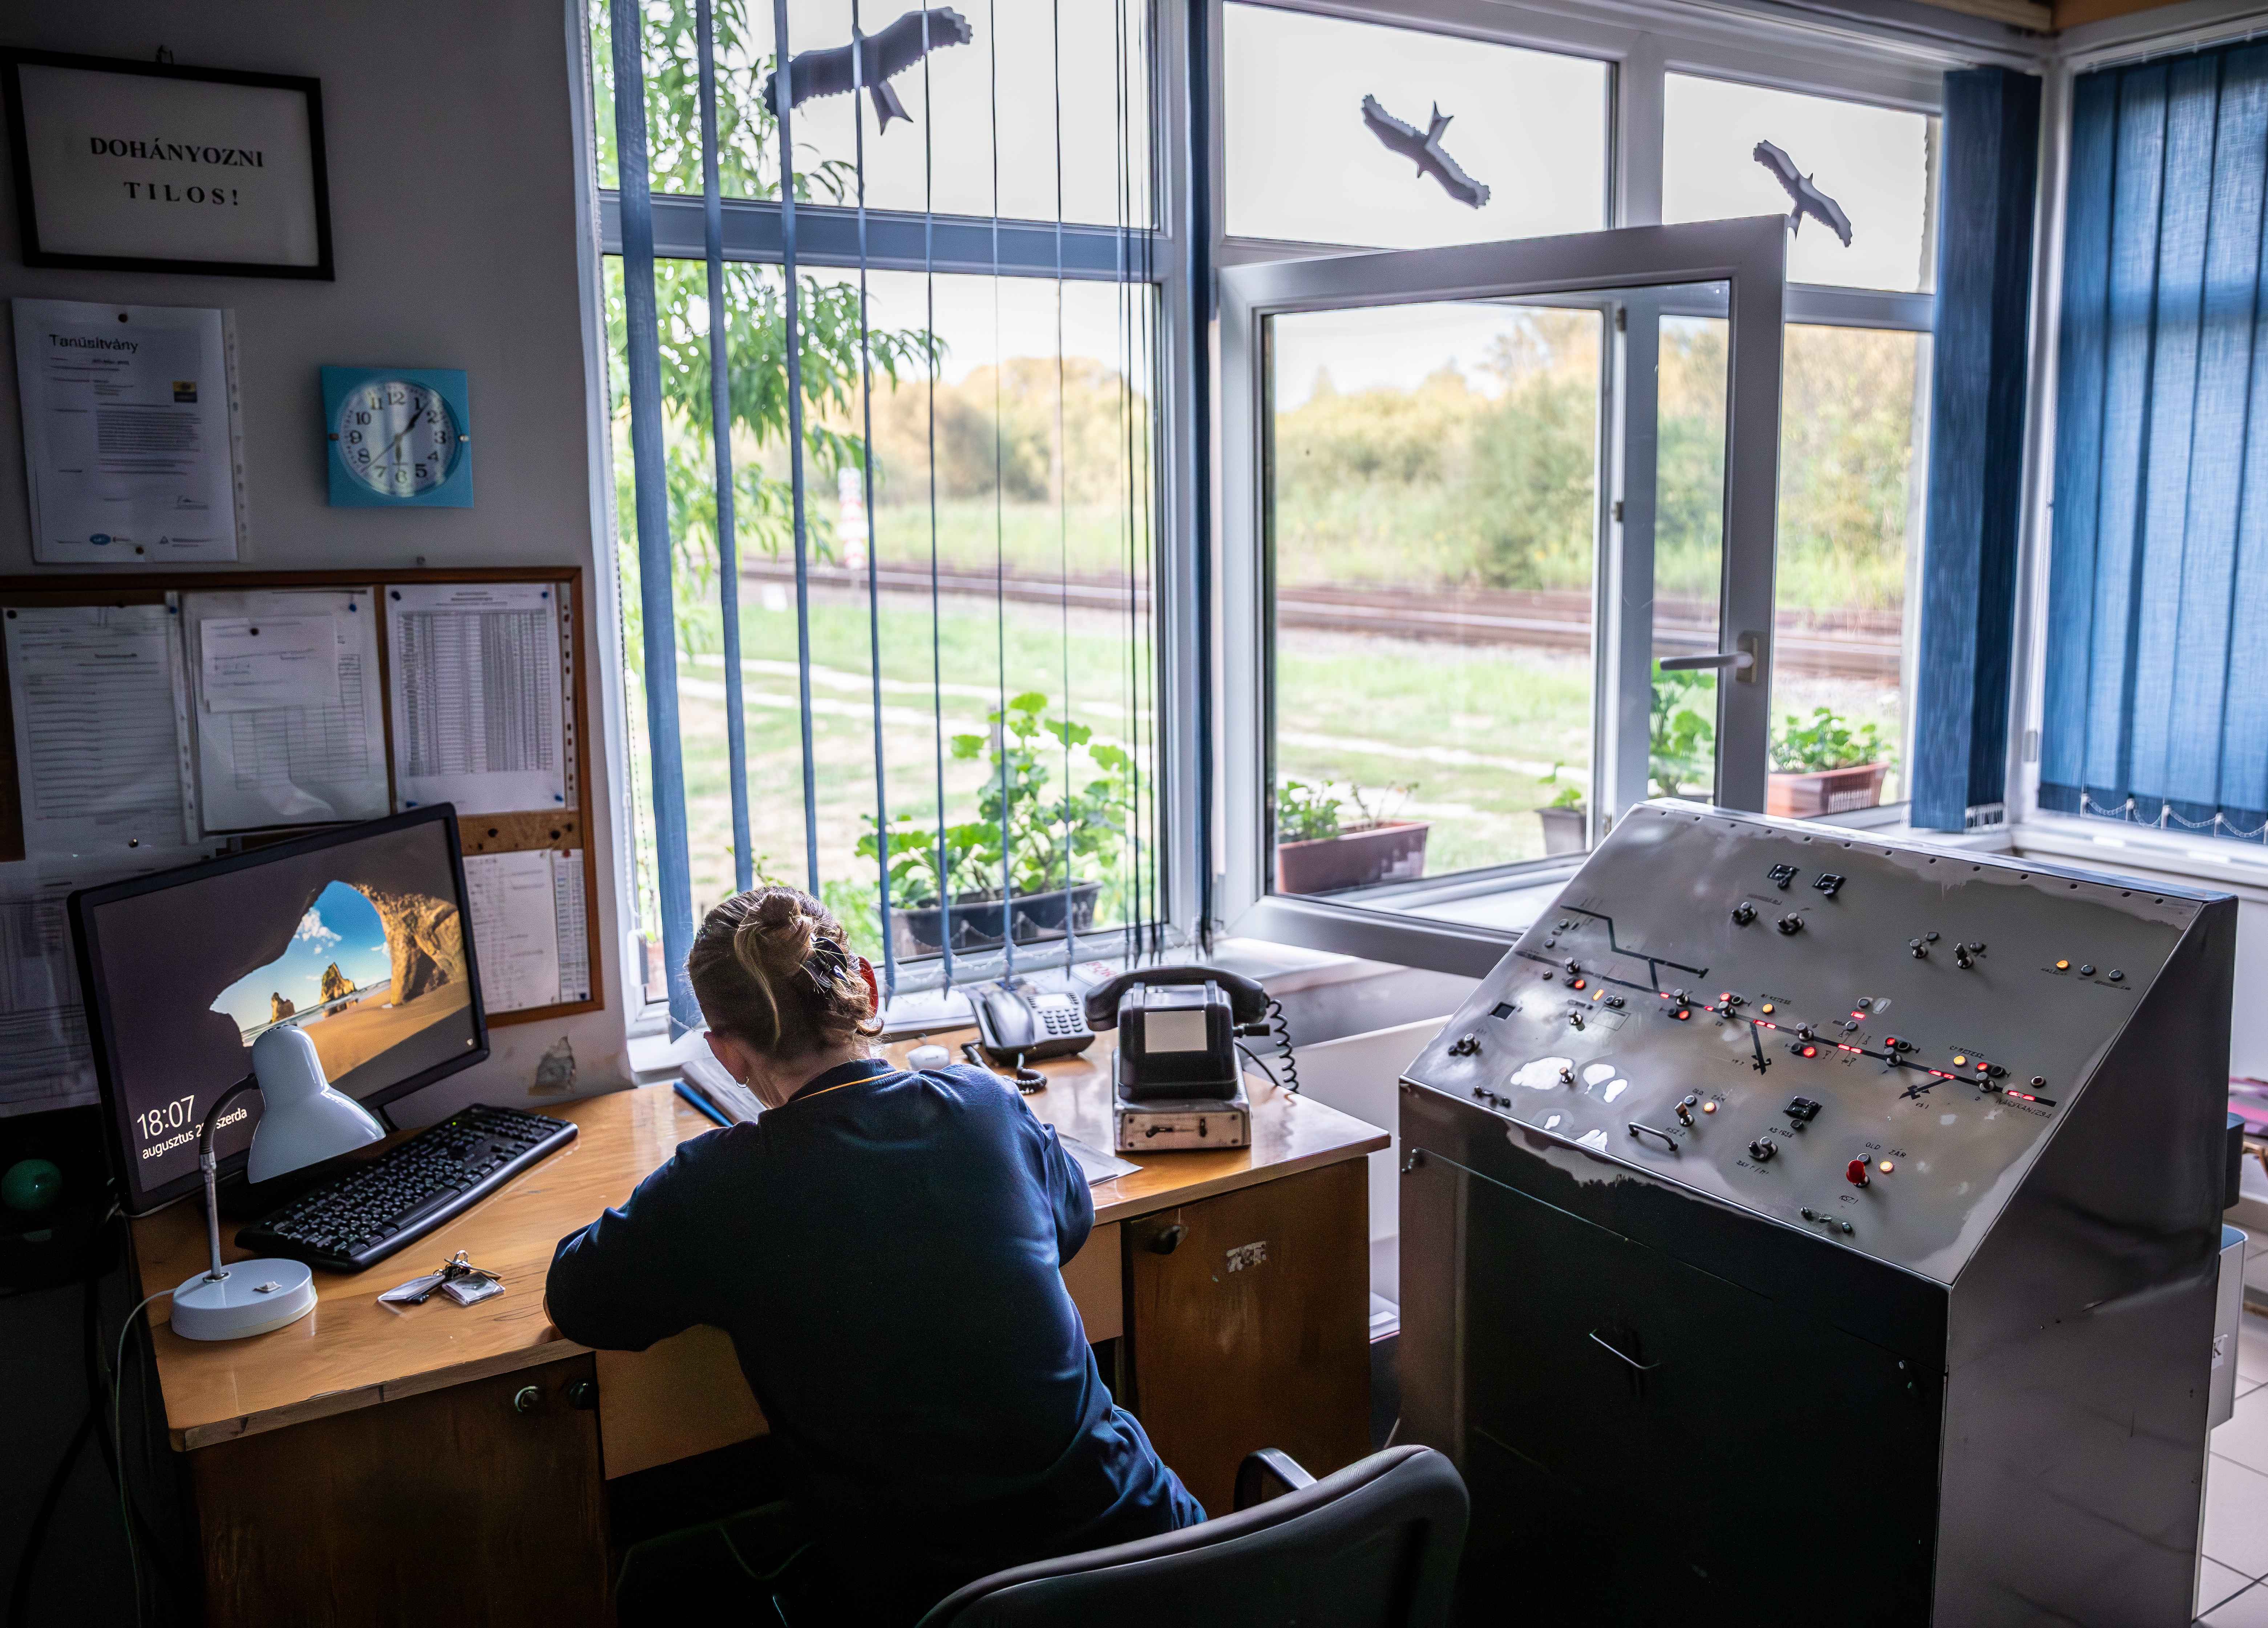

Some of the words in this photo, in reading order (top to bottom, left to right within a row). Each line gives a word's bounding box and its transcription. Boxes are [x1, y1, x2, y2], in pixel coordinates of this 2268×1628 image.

[90, 137, 263, 168] DOHÁNYOZNI
[124, 182, 238, 206] TILOS!
[371, 397, 383, 410] 11
[388, 392, 405, 405] 12
[414, 397, 421, 410] 1
[356, 412, 371, 425] 10
[426, 410, 438, 424] 2
[349, 430, 362, 444] 9
[434, 431, 446, 444] 3
[358, 448, 370, 464] 8
[427, 451, 439, 462] 4
[376, 466, 387, 477] 7
[395, 470, 407, 484] 6
[415, 463, 428, 478] 5
[137, 1095, 194, 1139] 18:07
[142, 1130, 194, 1160] augusztus
[217, 1108, 247, 1129] szerda
[1888, 1149, 1907, 1158] ZÁR
